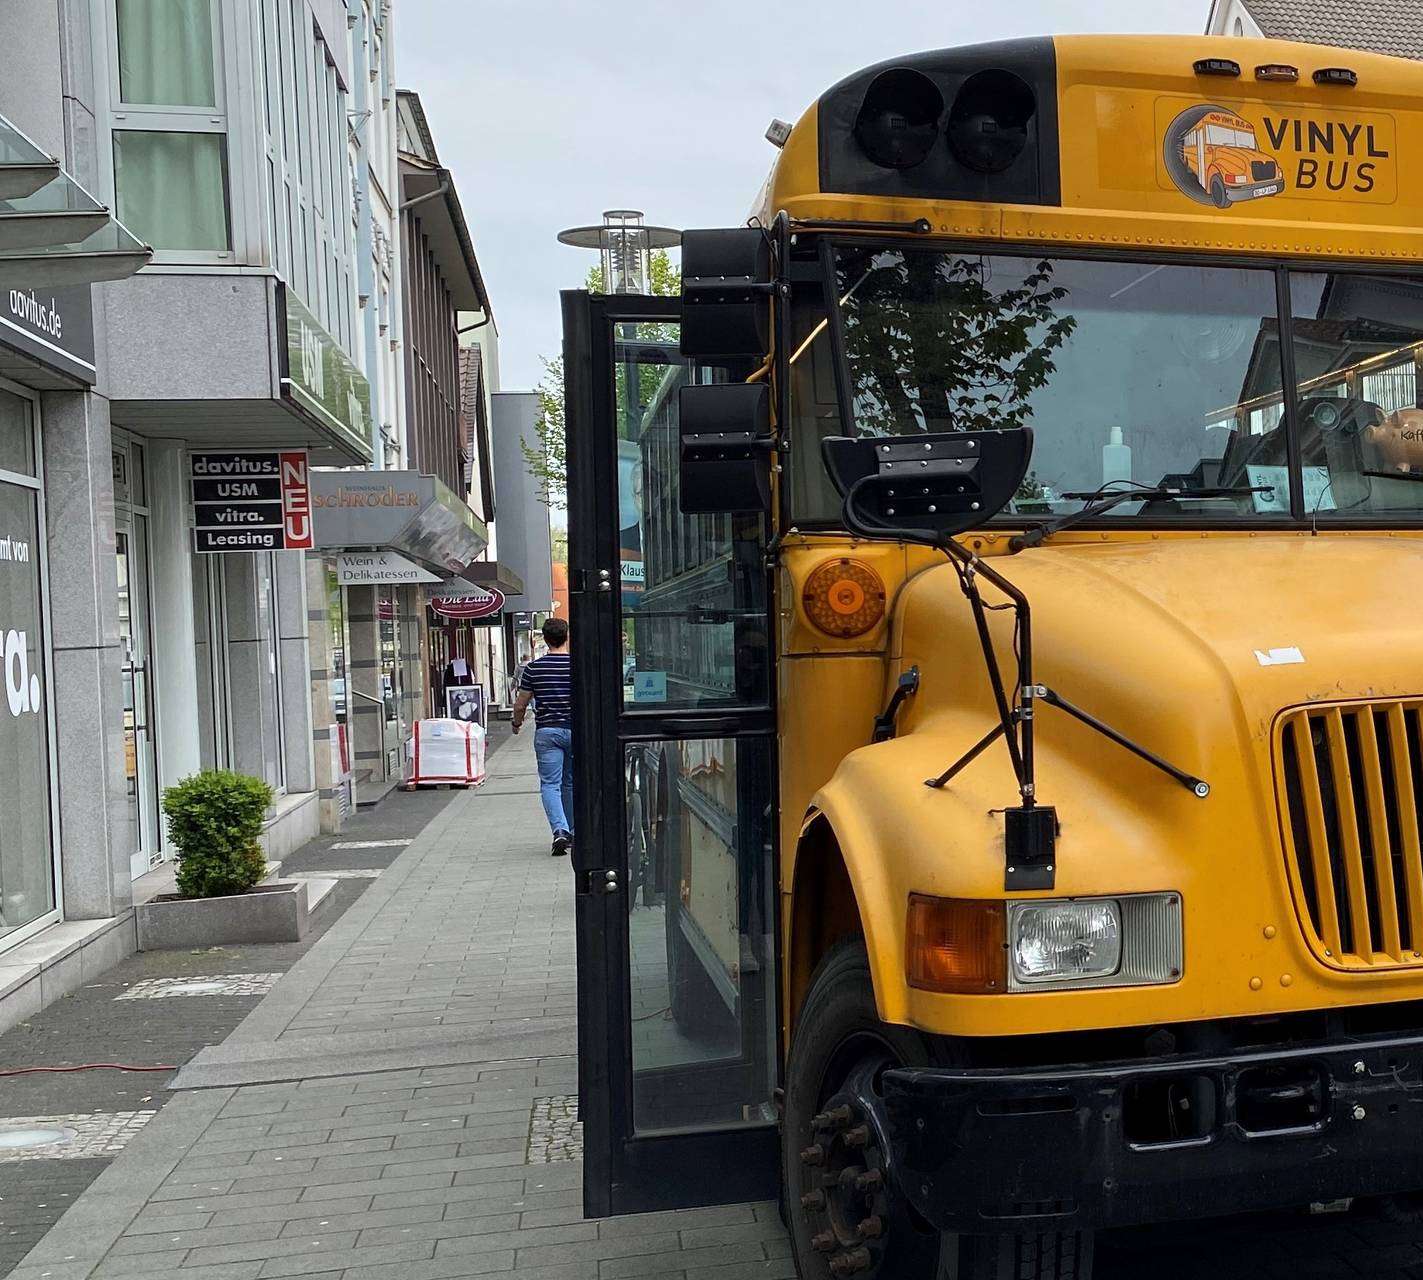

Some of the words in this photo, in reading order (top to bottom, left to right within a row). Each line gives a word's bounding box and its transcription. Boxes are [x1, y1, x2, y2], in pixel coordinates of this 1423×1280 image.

[1263, 117, 1389, 158] VINYL
[1295, 159, 1376, 192] BUS
[194, 457, 279, 473] davitus.
[217, 483, 258, 496] USM
[283, 461, 309, 540] NEU
[215, 508, 264, 522] vitra.
[207, 532, 274, 547] Leasing
[12, 541, 29, 562] von
[343, 556, 374, 567] Wein
[379, 556, 388, 565] &
[343, 569, 418, 580] Delikatessen
[620, 563, 646, 577] Klaus
